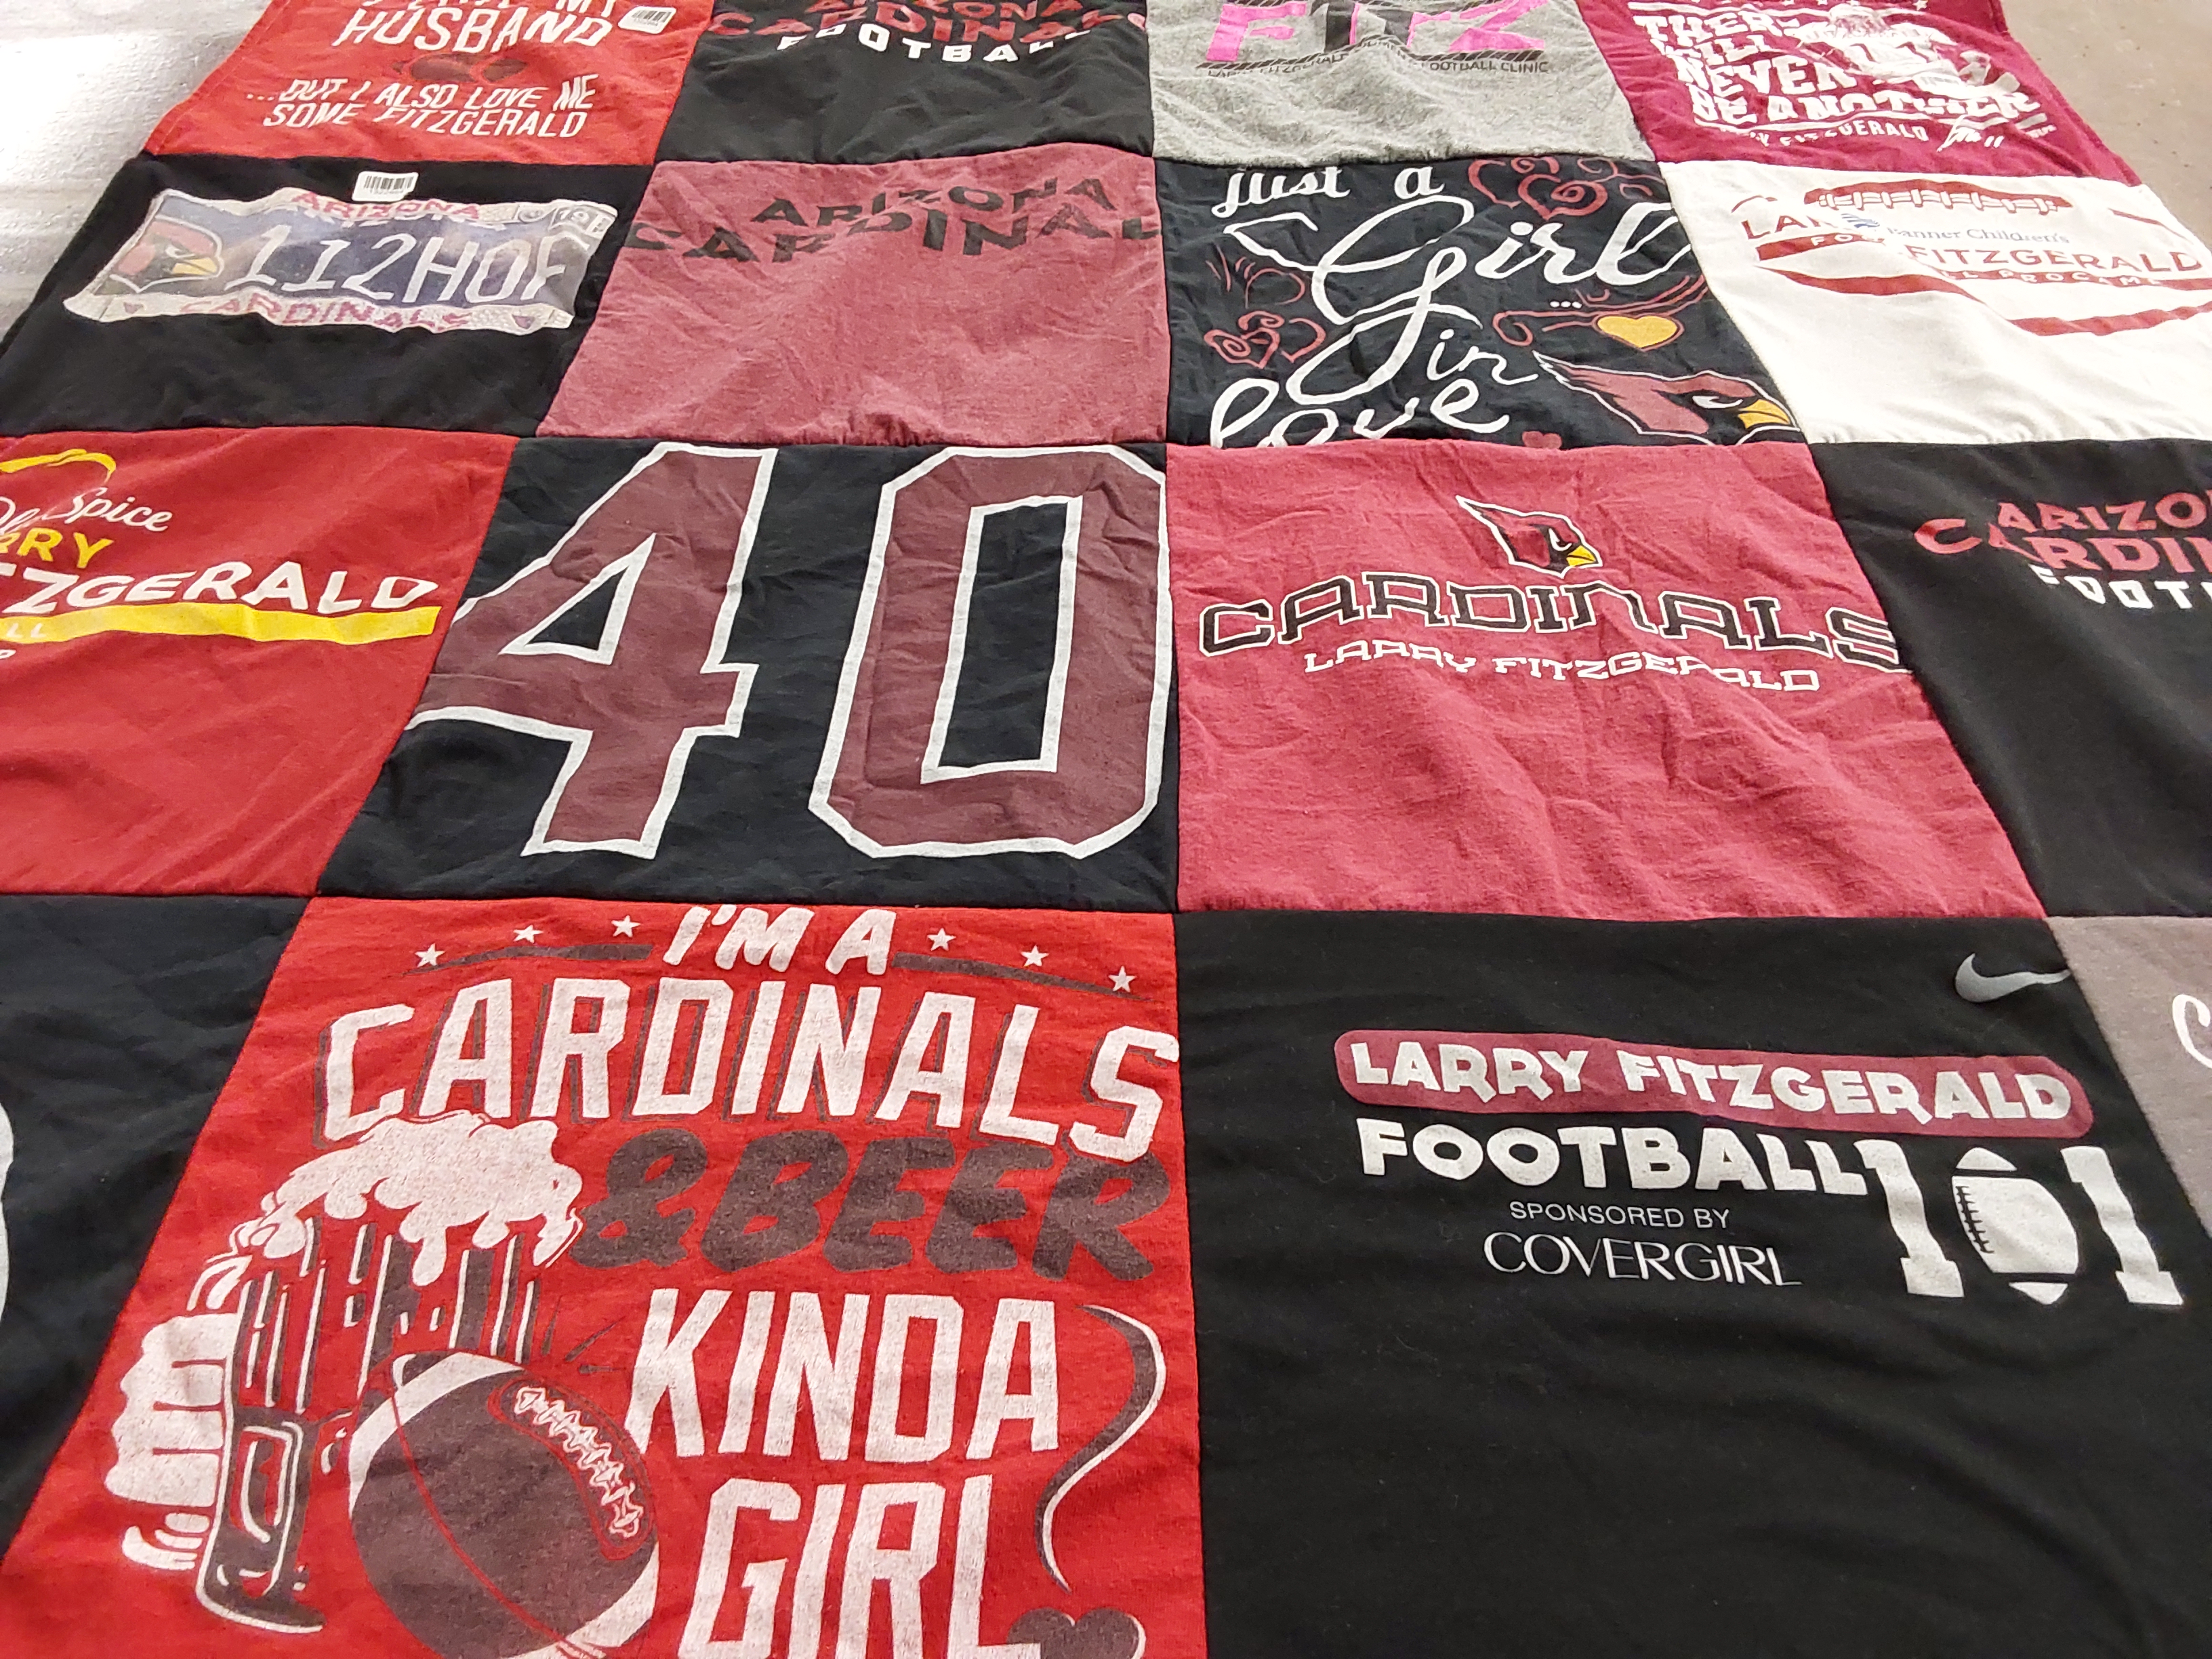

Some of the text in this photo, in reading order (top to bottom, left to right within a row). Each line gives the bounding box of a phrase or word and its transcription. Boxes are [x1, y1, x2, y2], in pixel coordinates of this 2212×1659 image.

[331, 6, 613, 53] HUSBAND
[349, 81, 372, 101] I
[373, 82, 459, 108] ALSO
[464, 86, 549, 110] LOVE
[552, 74, 600, 112] ME
[1421, 61, 1496, 72] OOTBALL
[1500, 62, 1549, 73] CLINIC
[262, 102, 588, 138] SOME FITZGERALD
[291, 190, 479, 218] ARIZONA
[751, 177, 1115, 228] ARIZONA
[1211, 166, 1446, 218] just a
[1902, 244, 2204, 272] FITZGERALD
[180, 292, 472, 331] CARDINALS
[1224, 194, 1693, 405] Girl
[1427, 328, 1541, 387] in
[1210, 378, 1511, 448] love
[42, 487, 173, 532] Spice
[1996, 489, 2212, 533] ARIZO
[0, 562, 439, 613] ZGERALD
[1198, 570, 1910, 673] CARDINALS
[407, 441, 1174, 859] 40
[1305, 638, 1821, 691] LARRY FITZGERALD
[663, 905, 895, 975] I'M A
[317, 977, 1181, 1163] CARDINALS
[1351, 1041, 2072, 1126] LARRY FITZGERALD
[1356, 1118, 1868, 1197] FOOTBALL
[1509, 1200, 1729, 1229] SPONSORED BY
[1483, 1231, 1803, 1286] COVERGIRL
[625, 1288, 1059, 1463] KINDA
[677, 1473, 1042, 1659] GIRL
